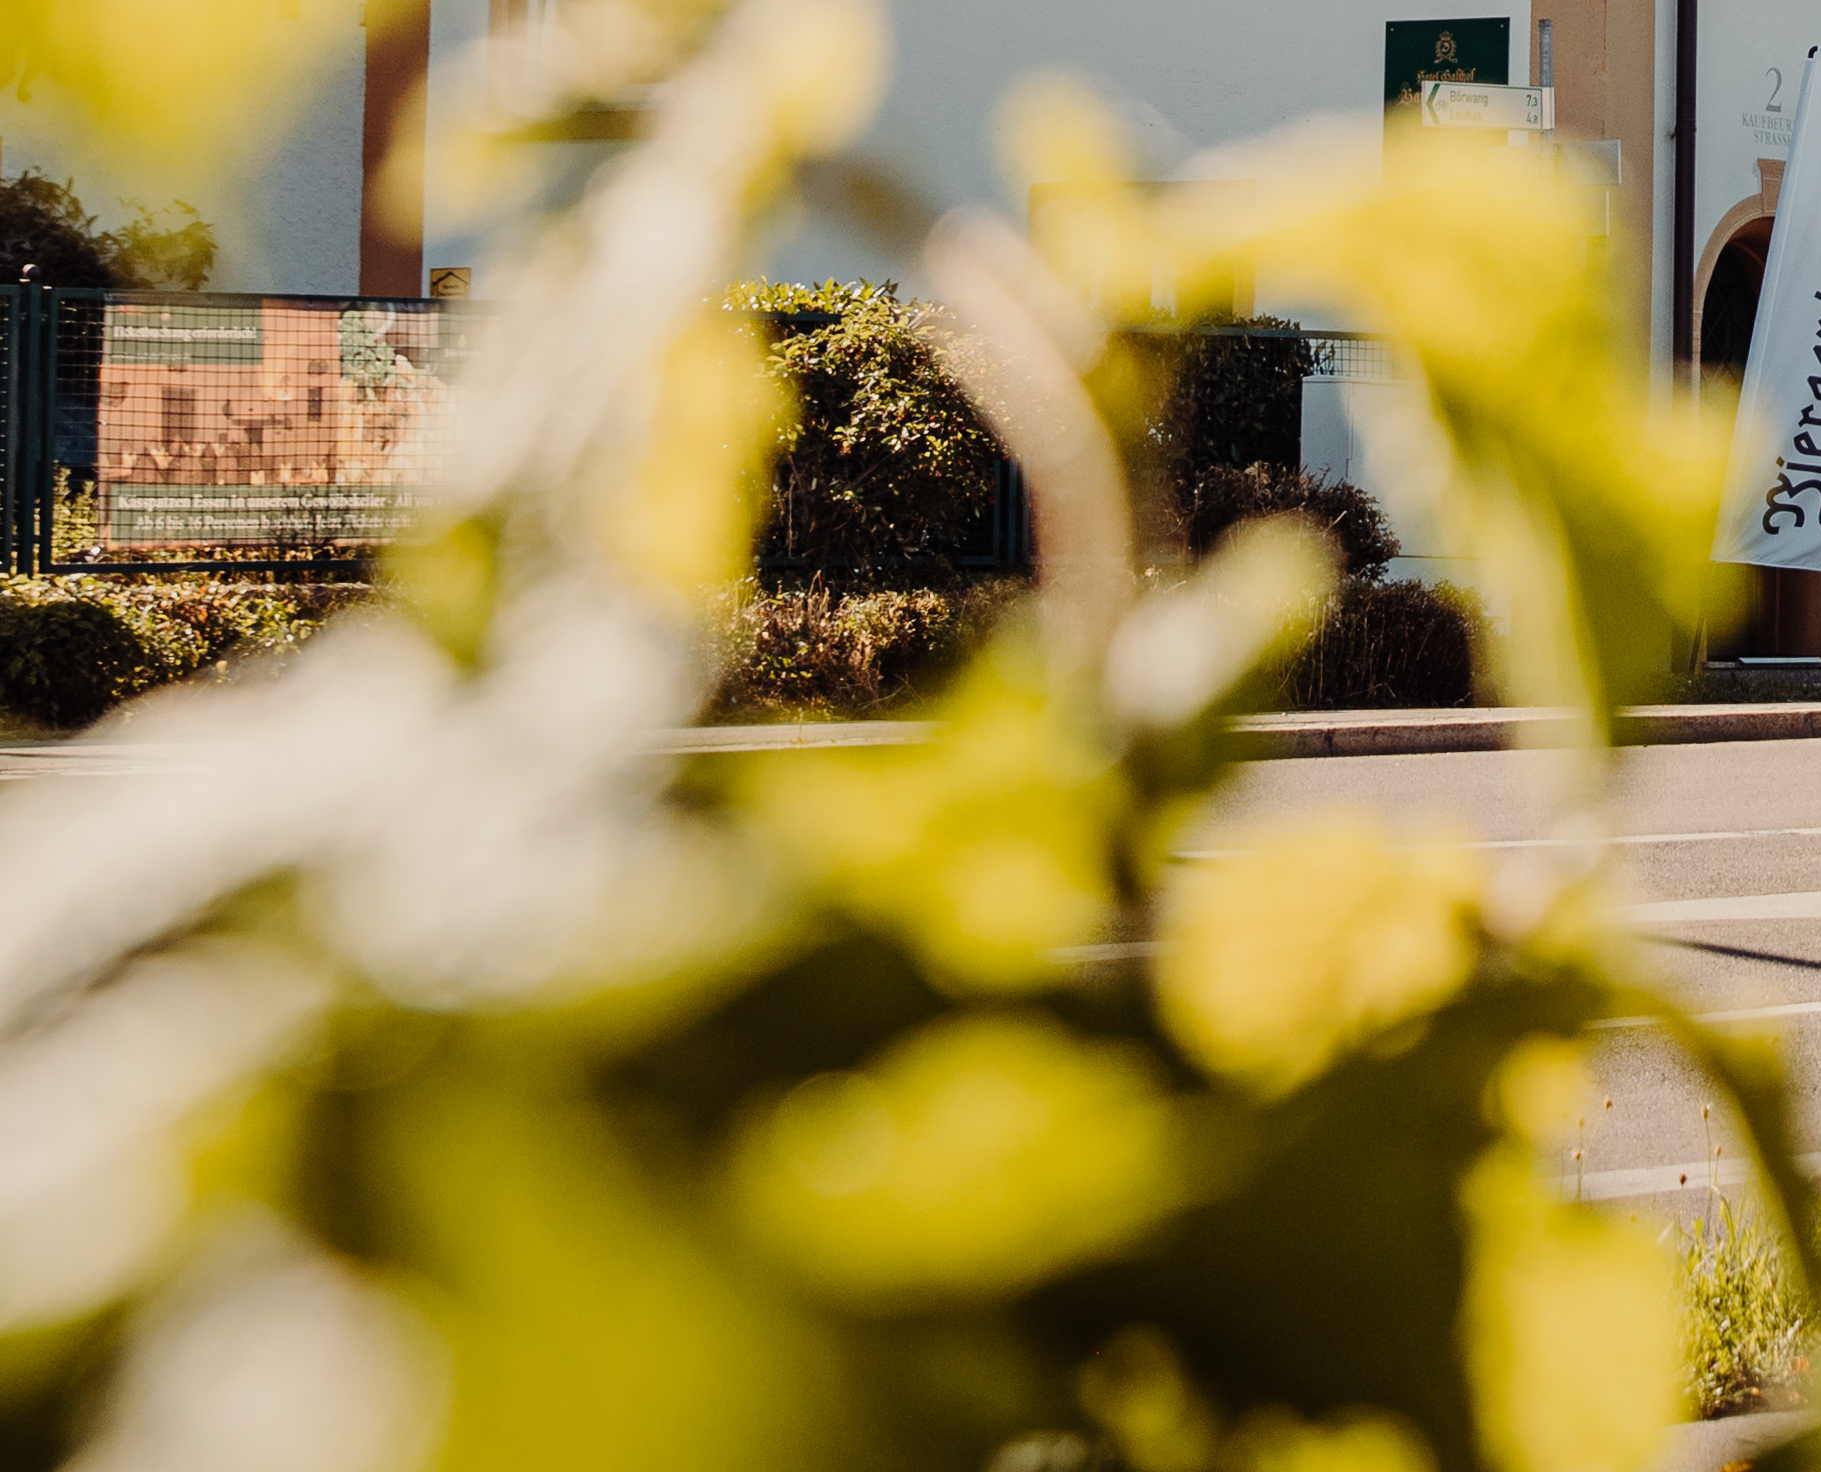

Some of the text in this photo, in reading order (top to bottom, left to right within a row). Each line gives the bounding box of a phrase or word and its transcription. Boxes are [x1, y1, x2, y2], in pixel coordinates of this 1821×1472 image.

[1449, 90, 1489, 107] Börwang
[1765, 67, 1782, 112] 2
[1742, 113, 1793, 132] KAUFBEUR
